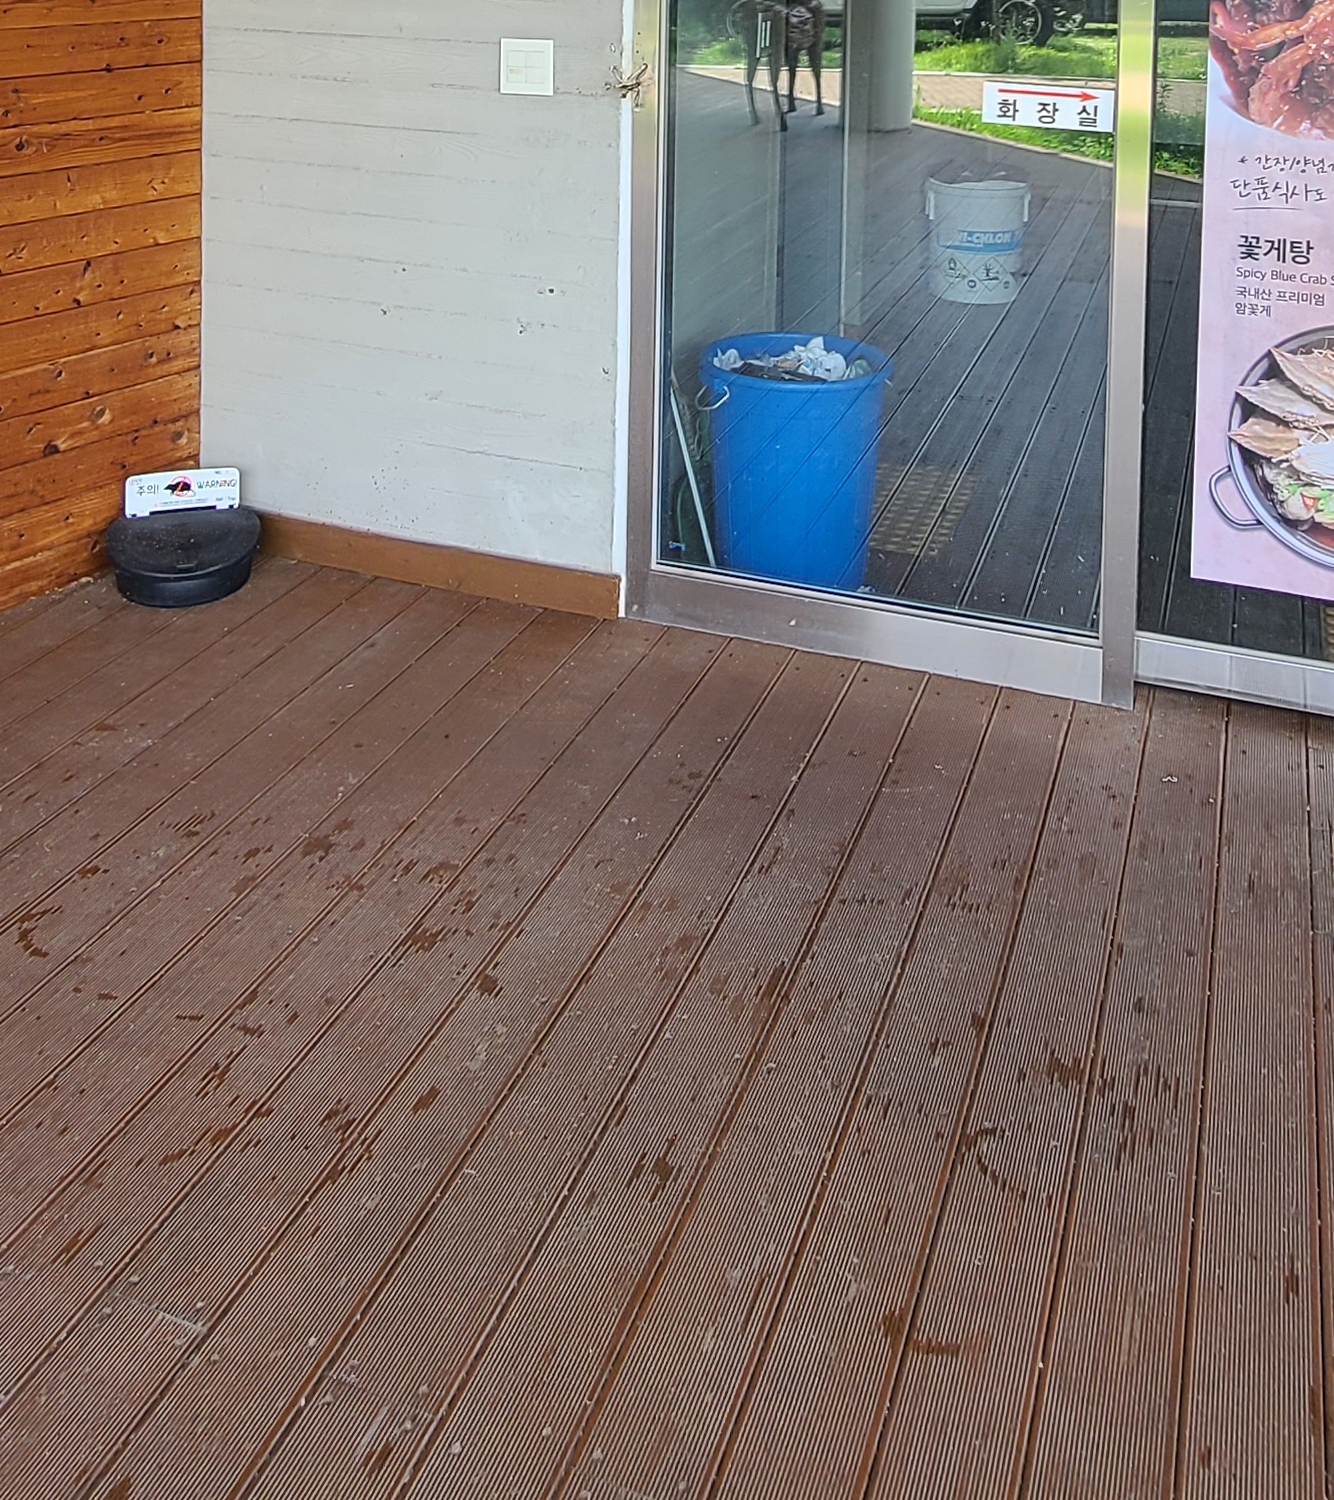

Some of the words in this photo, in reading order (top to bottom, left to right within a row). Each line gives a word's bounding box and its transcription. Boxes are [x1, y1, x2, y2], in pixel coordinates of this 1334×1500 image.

[1230, 176, 1328, 204] 단품식사도
[1237, 235, 1314, 265] 꽃게탕
[1236, 267, 1266, 281] Spicy
[1270, 270, 1296, 283] Blue
[1299, 273, 1327, 285] Crab
[1236, 286, 1272, 301] 국내산
[1275, 290, 1325, 306] 프리미엄
[1235, 302, 1271, 317] 암꽃게
[197, 479, 237, 490] WARNING
